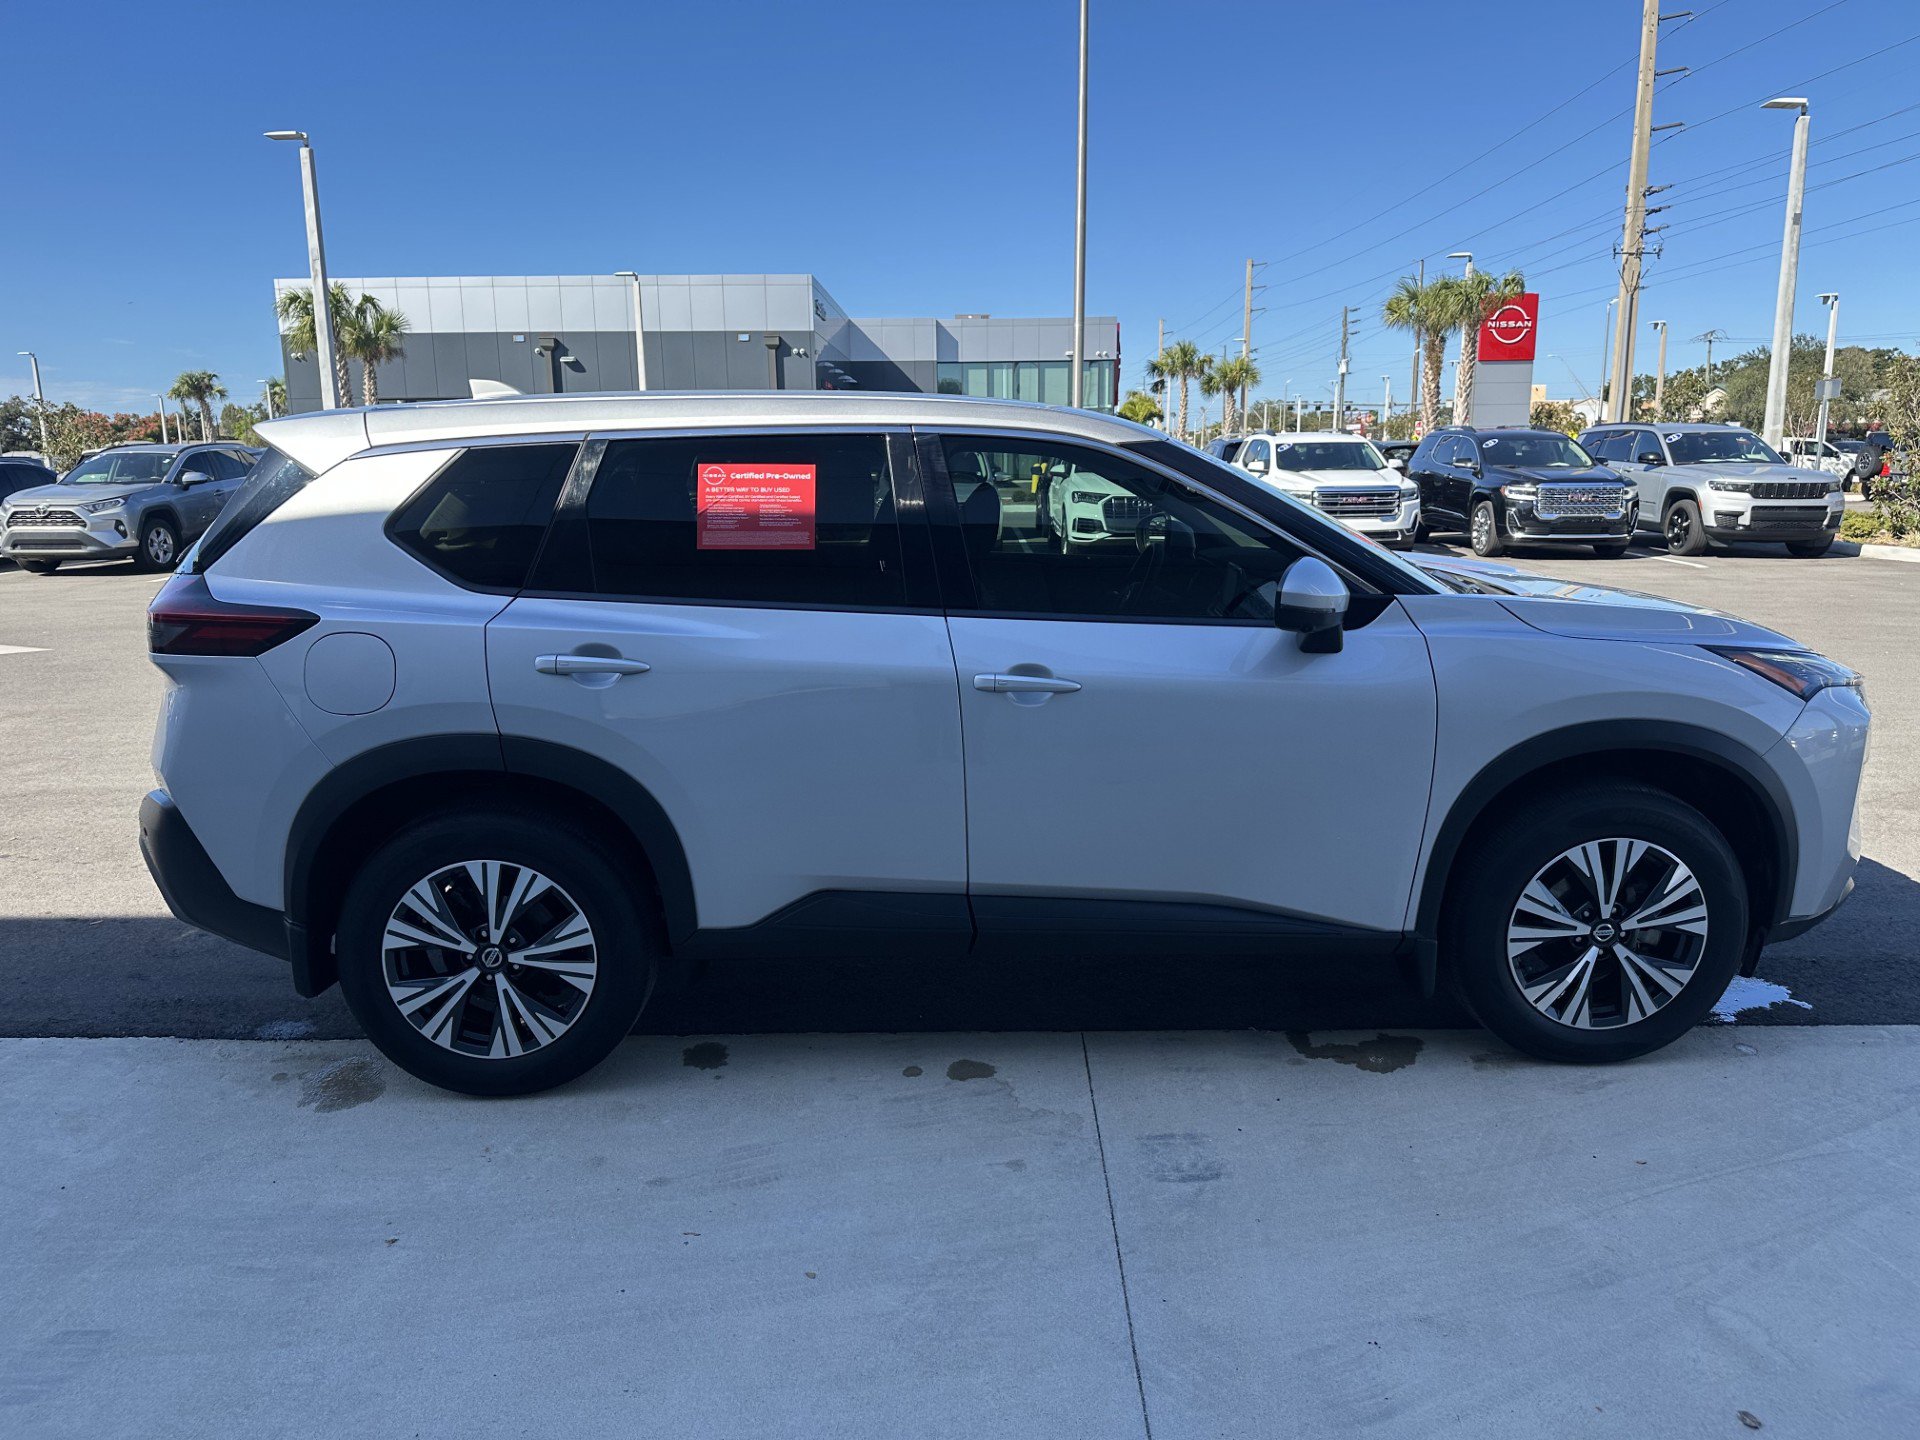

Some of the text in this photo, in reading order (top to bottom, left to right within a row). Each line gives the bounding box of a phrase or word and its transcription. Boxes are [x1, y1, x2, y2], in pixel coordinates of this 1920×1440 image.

[1487, 320, 1532, 328] NISSAN
[730, 472, 764, 480] Certified
[766, 472, 811, 480] Pre-Owned
